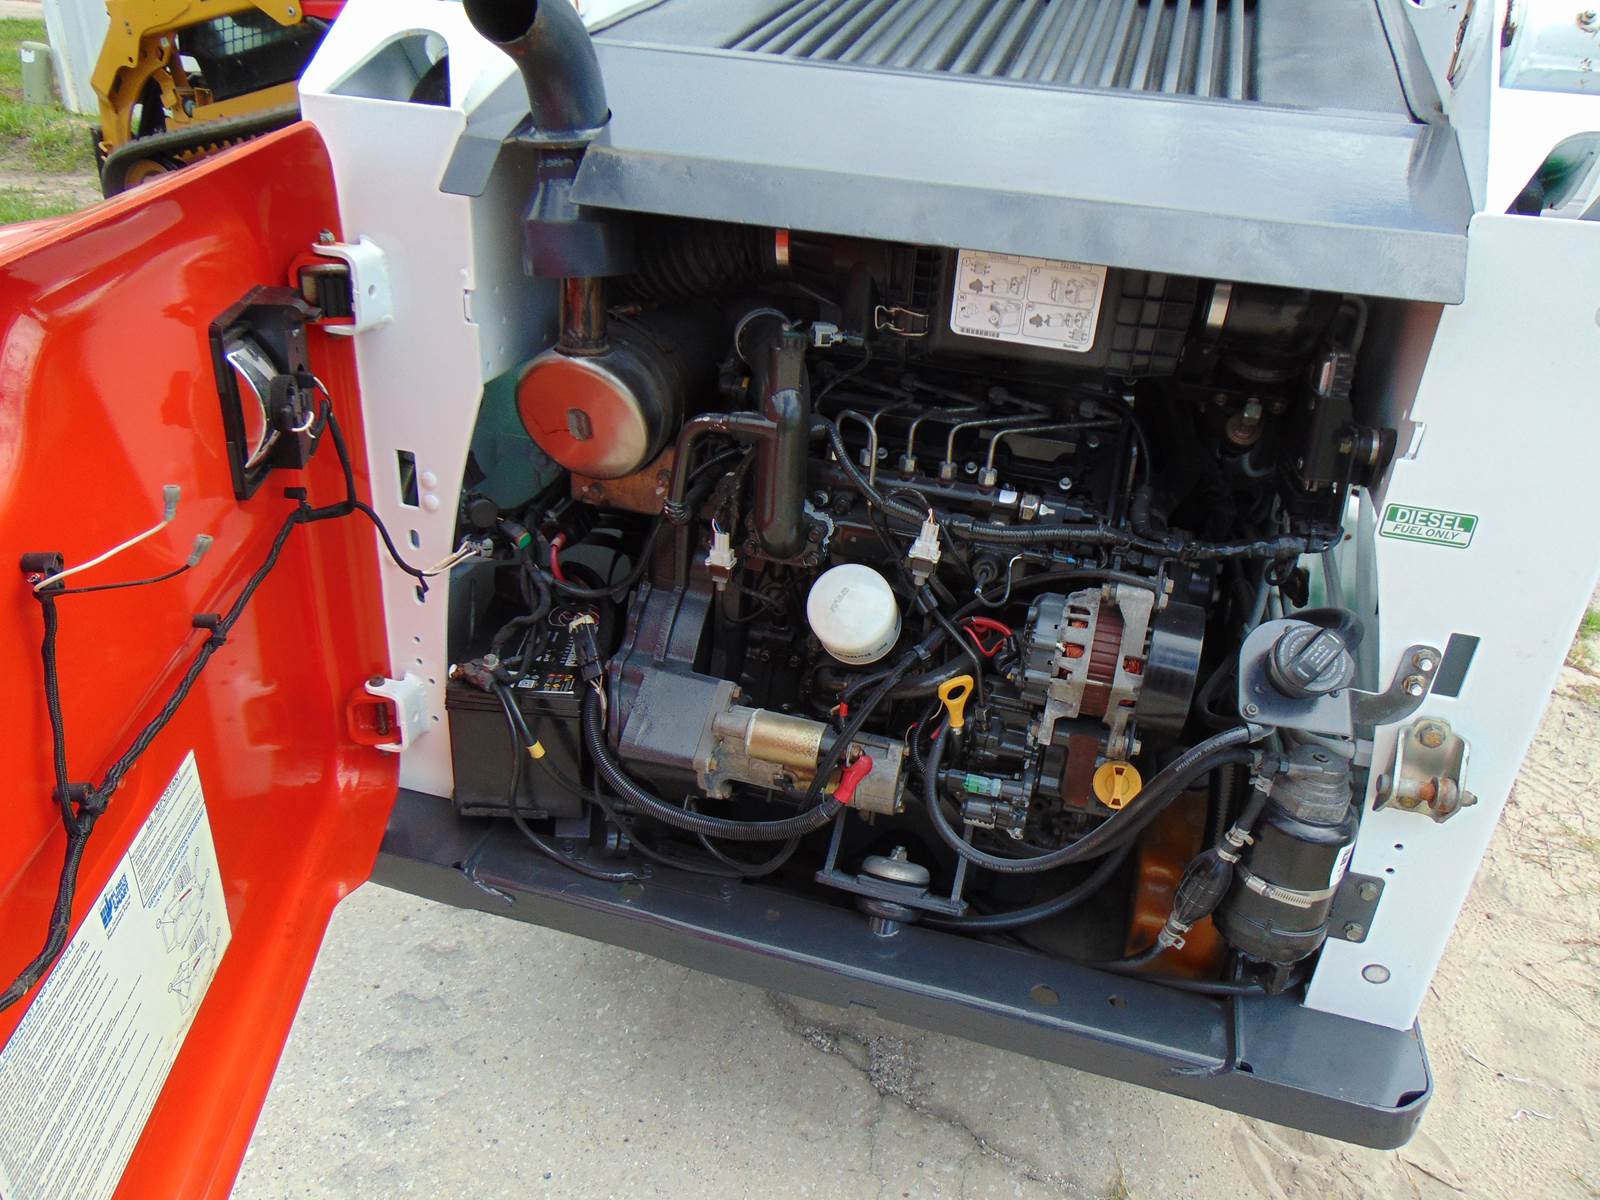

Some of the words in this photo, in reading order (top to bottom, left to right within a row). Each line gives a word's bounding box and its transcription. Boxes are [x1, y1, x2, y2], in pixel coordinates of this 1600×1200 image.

[1395, 508, 1465, 531] DIESEL
[1393, 523, 1424, 536] FUEL
[1425, 528, 1460, 540] ONLY
[2, 1005, 36, 1059] CHECKLIST
[35, 988, 48, 1006] AND
[48, 943, 76, 986] SCHEDULE
